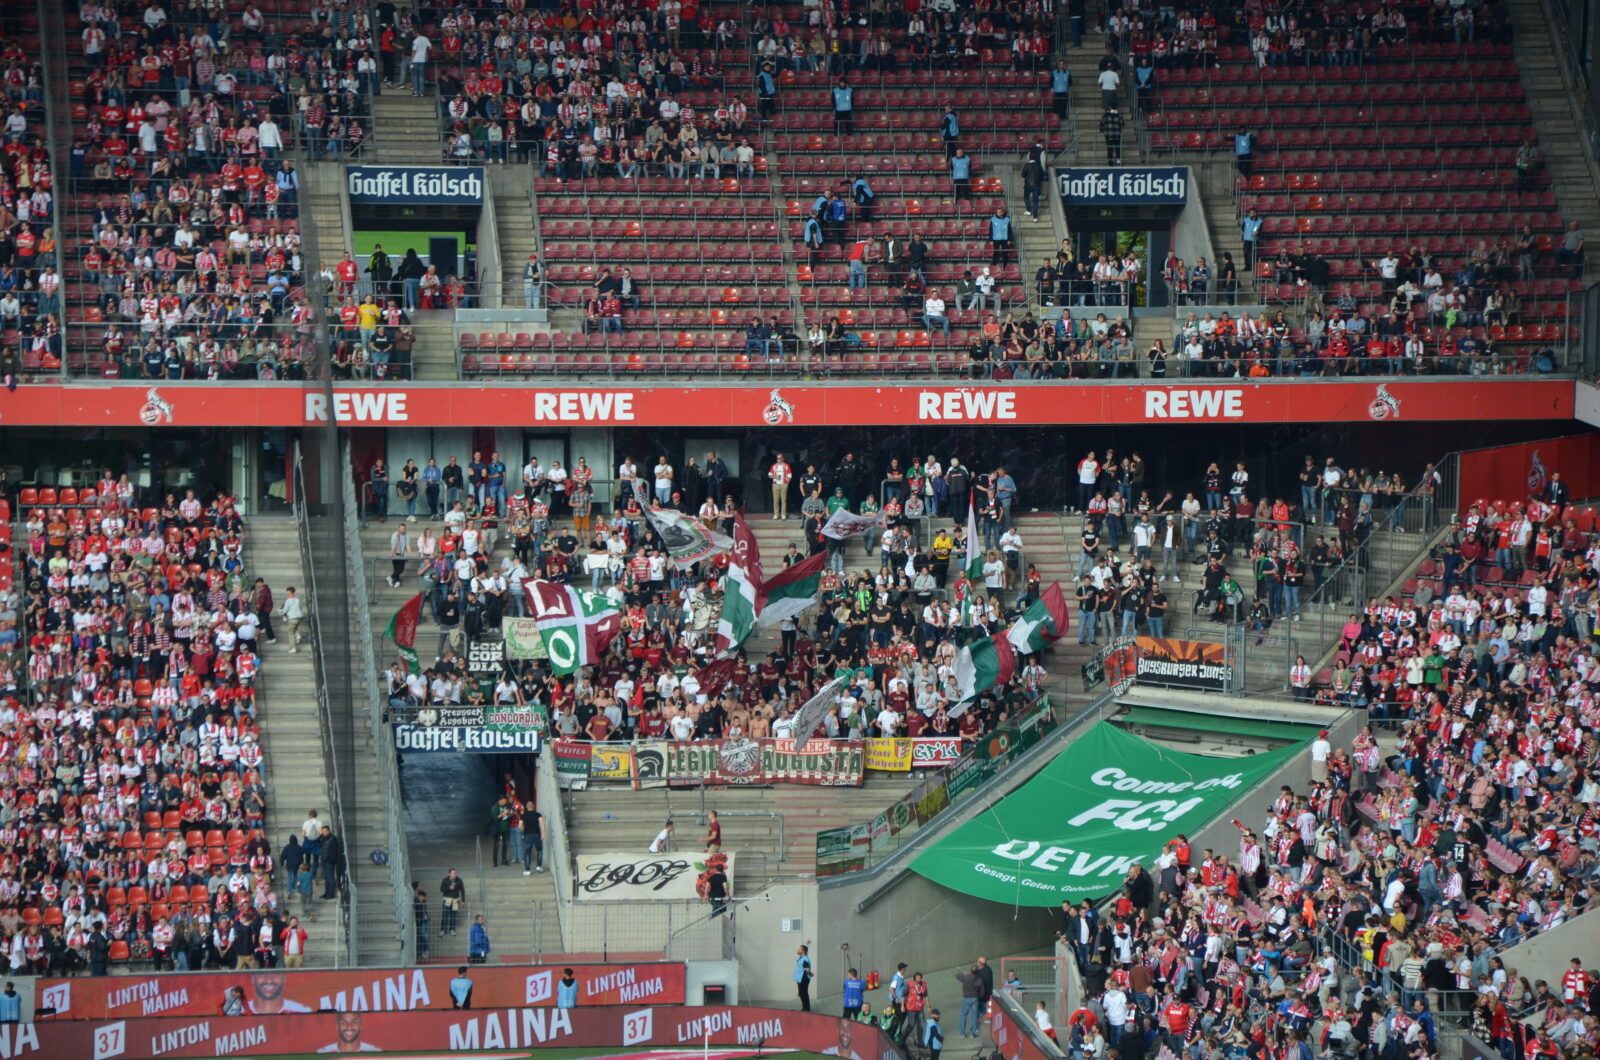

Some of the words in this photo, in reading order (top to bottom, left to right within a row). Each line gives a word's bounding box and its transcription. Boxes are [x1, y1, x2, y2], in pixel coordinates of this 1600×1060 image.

[349, 171, 409, 197] Gaffel
[413, 172, 481, 199] Kölsch
[1057, 173, 1116, 198] Gaffel
[1119, 172, 1184, 198] Kölsch
[305, 393, 408, 421] REWE
[535, 393, 634, 420] REWE
[919, 391, 1016, 419] REWE
[1145, 390, 1243, 417] REWE
[468, 661, 503, 672] DIA
[488, 712, 541, 724] CONCORDIA
[668, 744, 719, 772] LEGIO
[775, 739, 830, 752] KICERS
[762, 751, 863, 774] AUGUSTA
[1091, 767, 1194, 794] Come
[1067, 797, 1205, 832] FC!
[975, 863, 1018, 883] Gesagt.
[1021, 878, 1057, 891] Getan.
[108, 979, 159, 1009] LINTON
[530, 976, 548, 998] 37
[587, 968, 635, 996] LINTON
[619, 977, 663, 1003] MAINA
[46, 989, 65, 1010] 37
[143, 988, 189, 1017] MAINA
[99, 1029, 121, 1054] 37
[152, 1021, 210, 1056] LINTON
[215, 1024, 267, 1056] MAINA
[448, 1008, 573, 1051] MAINA
[627, 1016, 647, 1040] 37
[737, 1018, 783, 1045] MAINA
